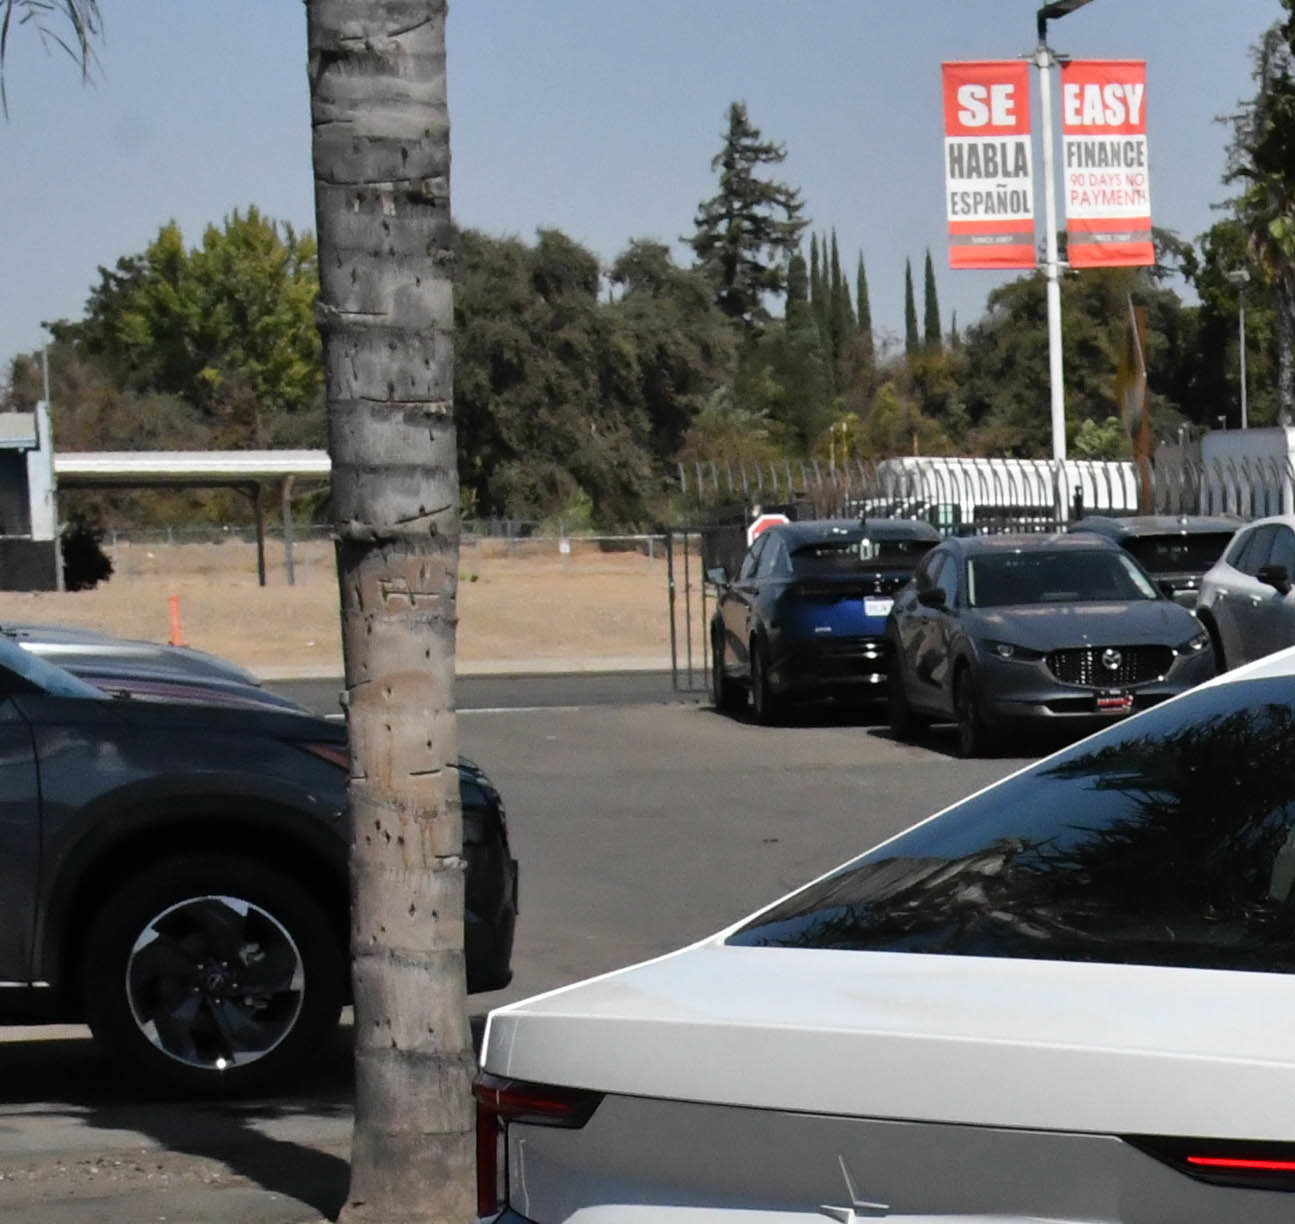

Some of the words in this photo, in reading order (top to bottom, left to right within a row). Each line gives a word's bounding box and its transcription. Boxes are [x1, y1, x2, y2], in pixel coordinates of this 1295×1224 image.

[957, 84, 1016, 127] SE
[1063, 83, 1144, 126] EASY
[949, 141, 1029, 180] HABLA
[1066, 141, 1144, 168] FINANCE
[1070, 173, 1085, 186] 90
[1089, 173, 1121, 186] DAYS
[1125, 173, 1145, 186] NO
[951, 183, 1030, 215] ESPAÑOL
